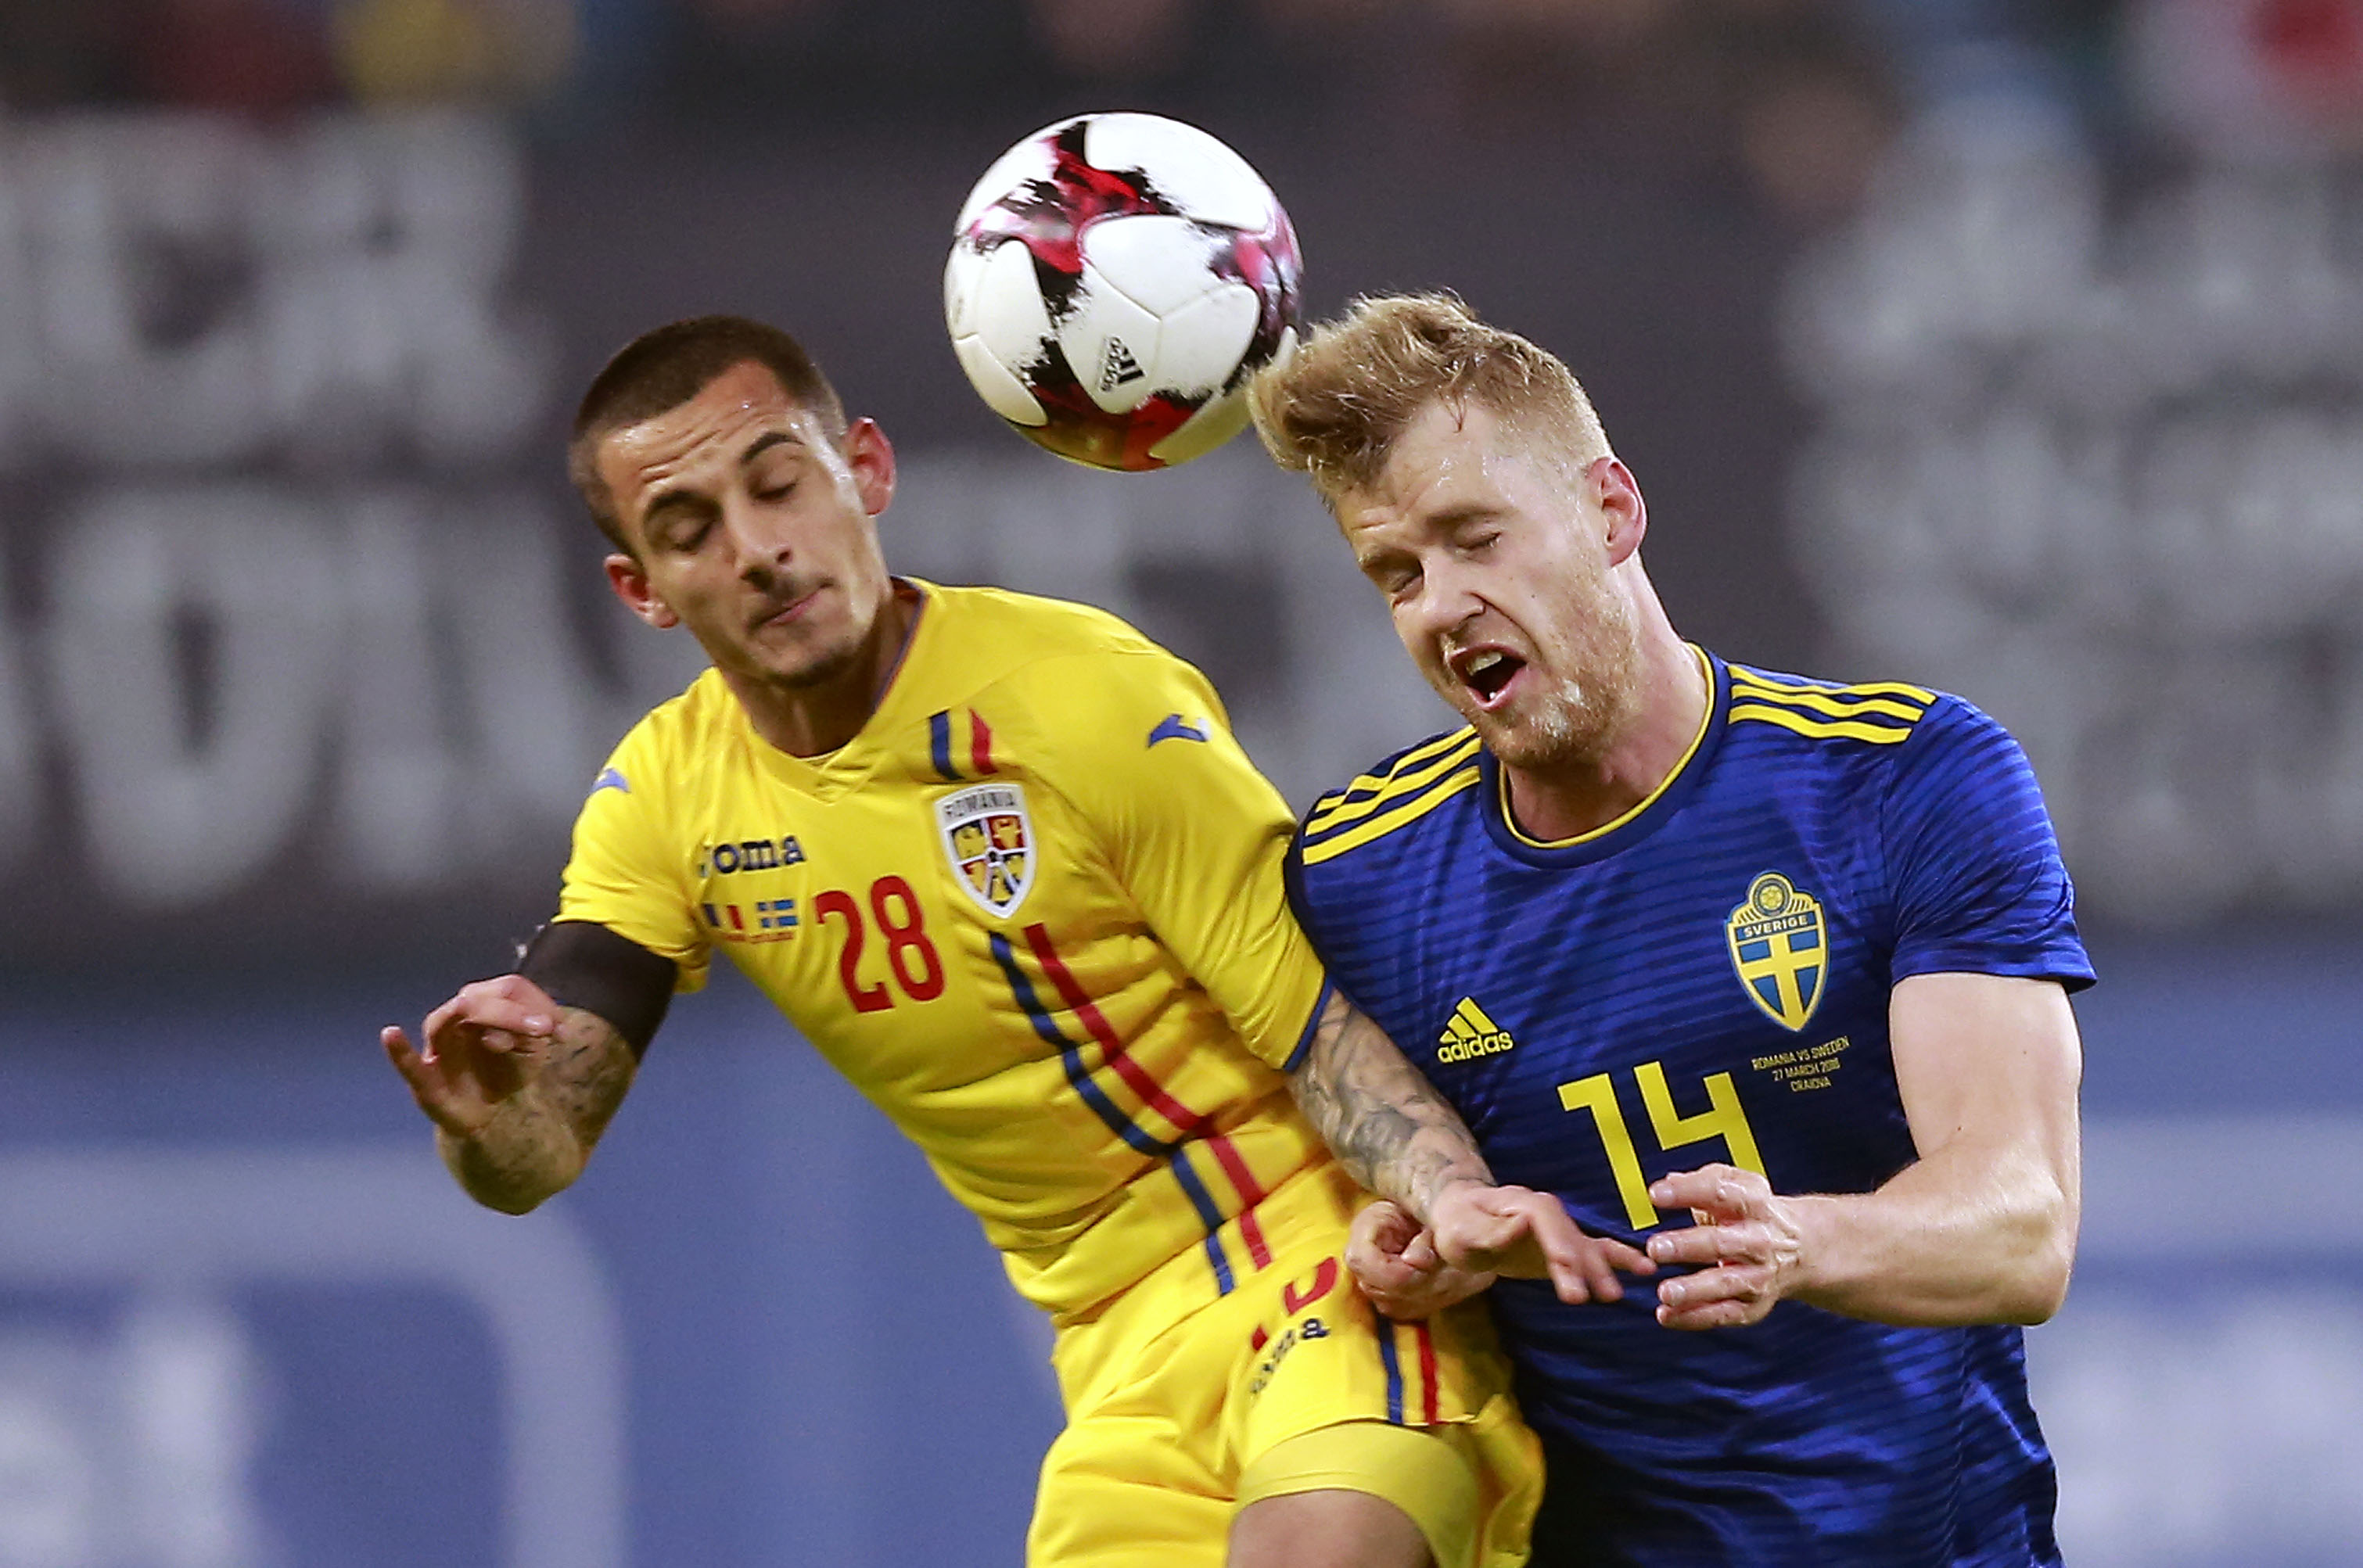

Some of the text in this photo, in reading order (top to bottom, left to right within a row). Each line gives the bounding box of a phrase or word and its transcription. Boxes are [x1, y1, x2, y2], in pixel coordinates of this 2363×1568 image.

[1744, 913, 1808, 938] SVERIGE
[813, 875, 945, 1014] 28
[1437, 1032, 1514, 1063] adidas
[1751, 1035, 1850, 1071] ROMANIA VS SWEDEN
[1772, 1068, 1783, 1081] 27
[1790, 1076, 1832, 1092] CRAIOVA
[1557, 1061, 1768, 1231] 14
